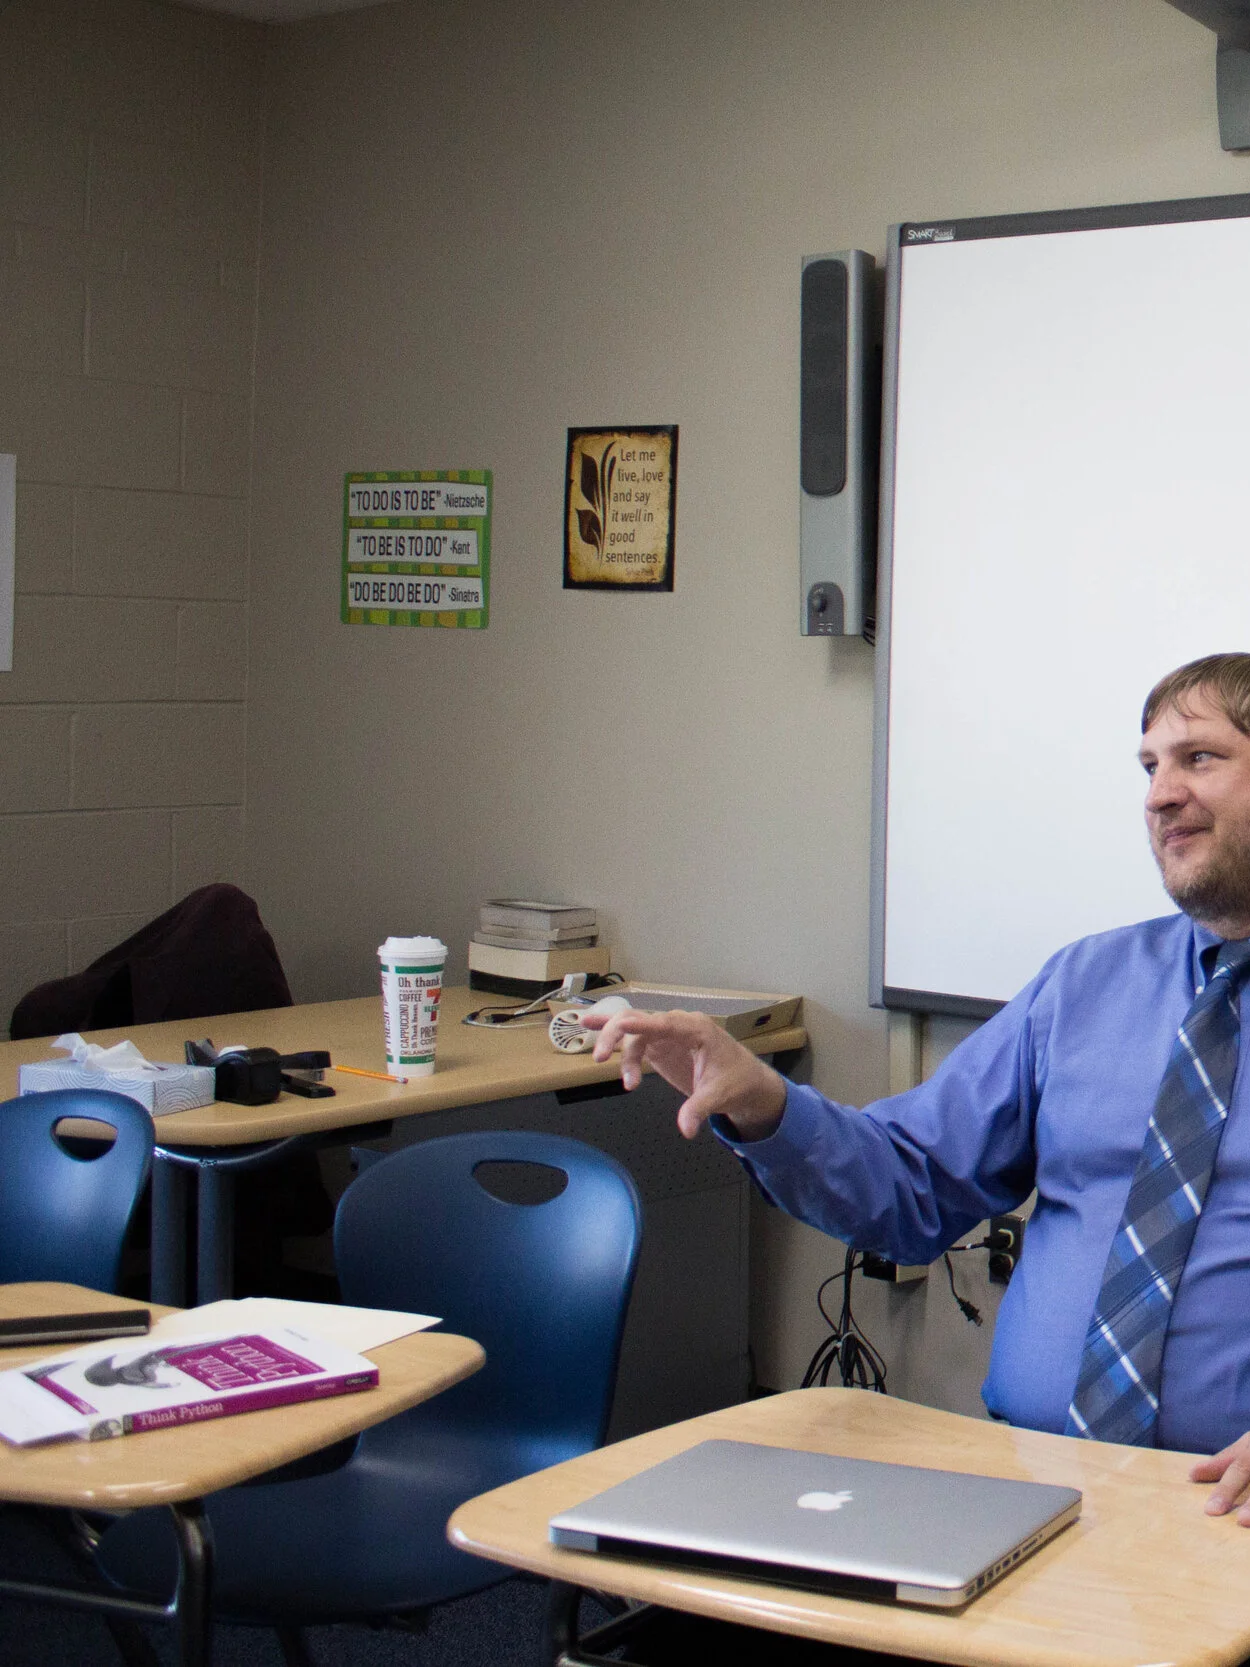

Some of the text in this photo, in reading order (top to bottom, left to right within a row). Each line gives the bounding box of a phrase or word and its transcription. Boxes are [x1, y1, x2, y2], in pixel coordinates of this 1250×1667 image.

[907, 228, 935, 240] SMART
[620, 449, 656, 462] Let me
[617, 468, 664, 483] live, love
[351, 490, 485, 511] "TO DO IS TO BE" -Nietzsche
[613, 489, 651, 505] and say
[611, 509, 654, 523] it well in
[609, 529, 636, 546] good
[357, 535, 471, 557] "TO BE IS TO DO" -Kant
[350, 581, 480, 604] "DO BE DO BE DO" -Sinatra
[398, 976, 411, 988] Oh
[398, 993, 422, 1002] COFFEE
[399, 1003, 409, 1049] CAPPUCCINO
[139, 1402, 224, 1426] Think Python
